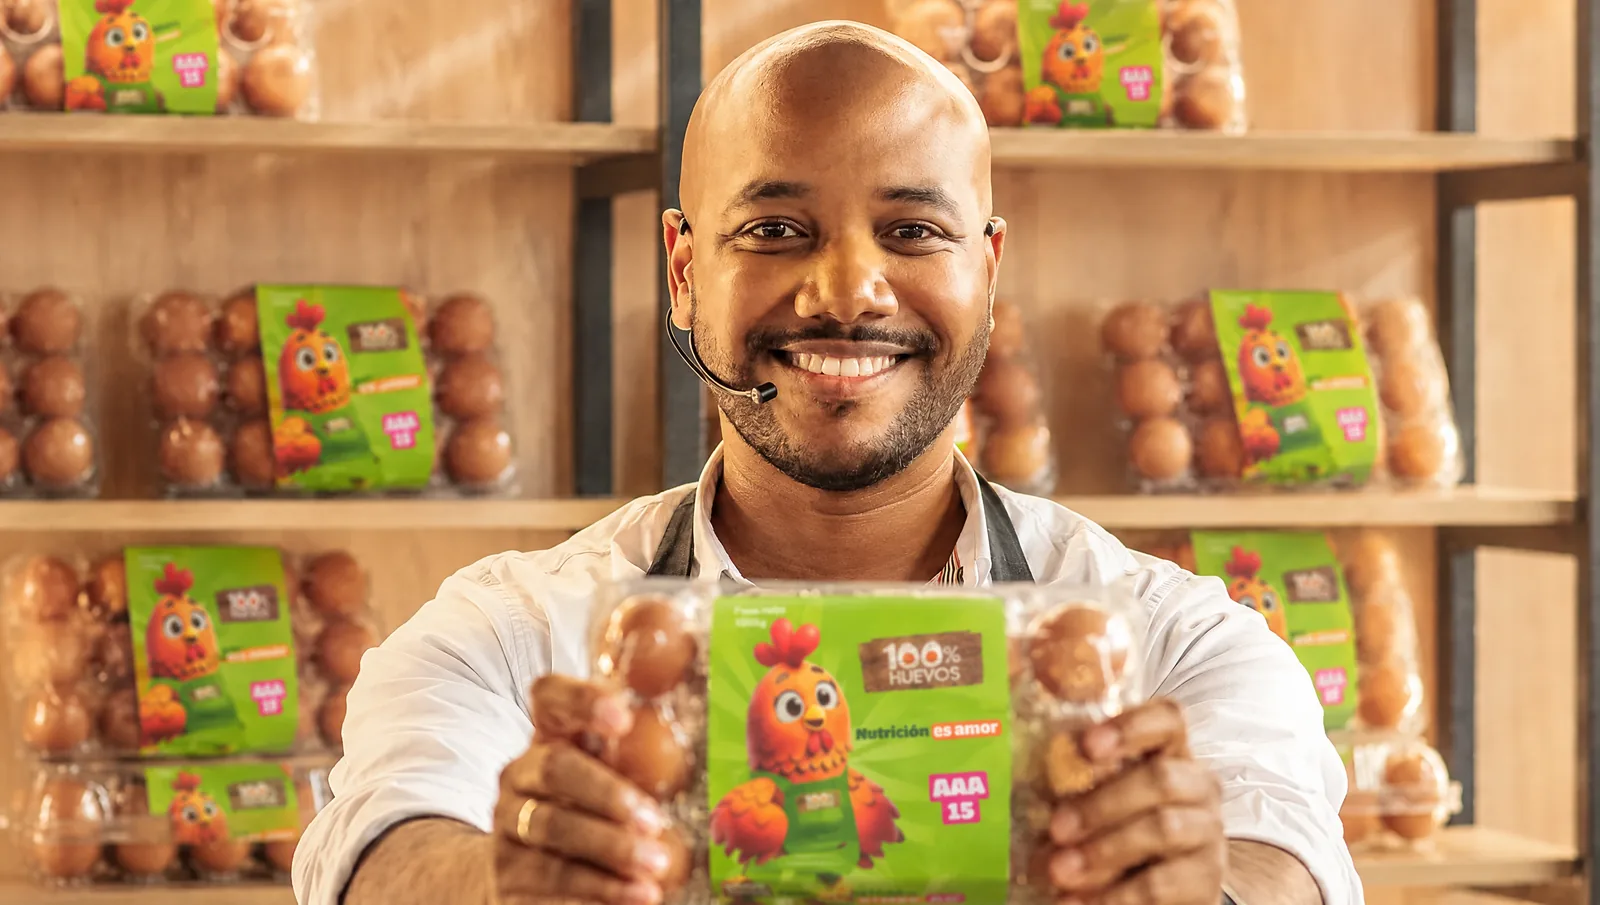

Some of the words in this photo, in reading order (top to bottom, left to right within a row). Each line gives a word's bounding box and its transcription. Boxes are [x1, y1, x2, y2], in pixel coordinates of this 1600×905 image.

[882, 640, 962, 671] 100%
[888, 665, 962, 686] HUEVOS
[855, 724, 930, 740] Nutrición
[933, 725, 952, 738] es
[954, 721, 999, 737] amor
[932, 775, 987, 799] AAA
[947, 801, 975, 821] 15
